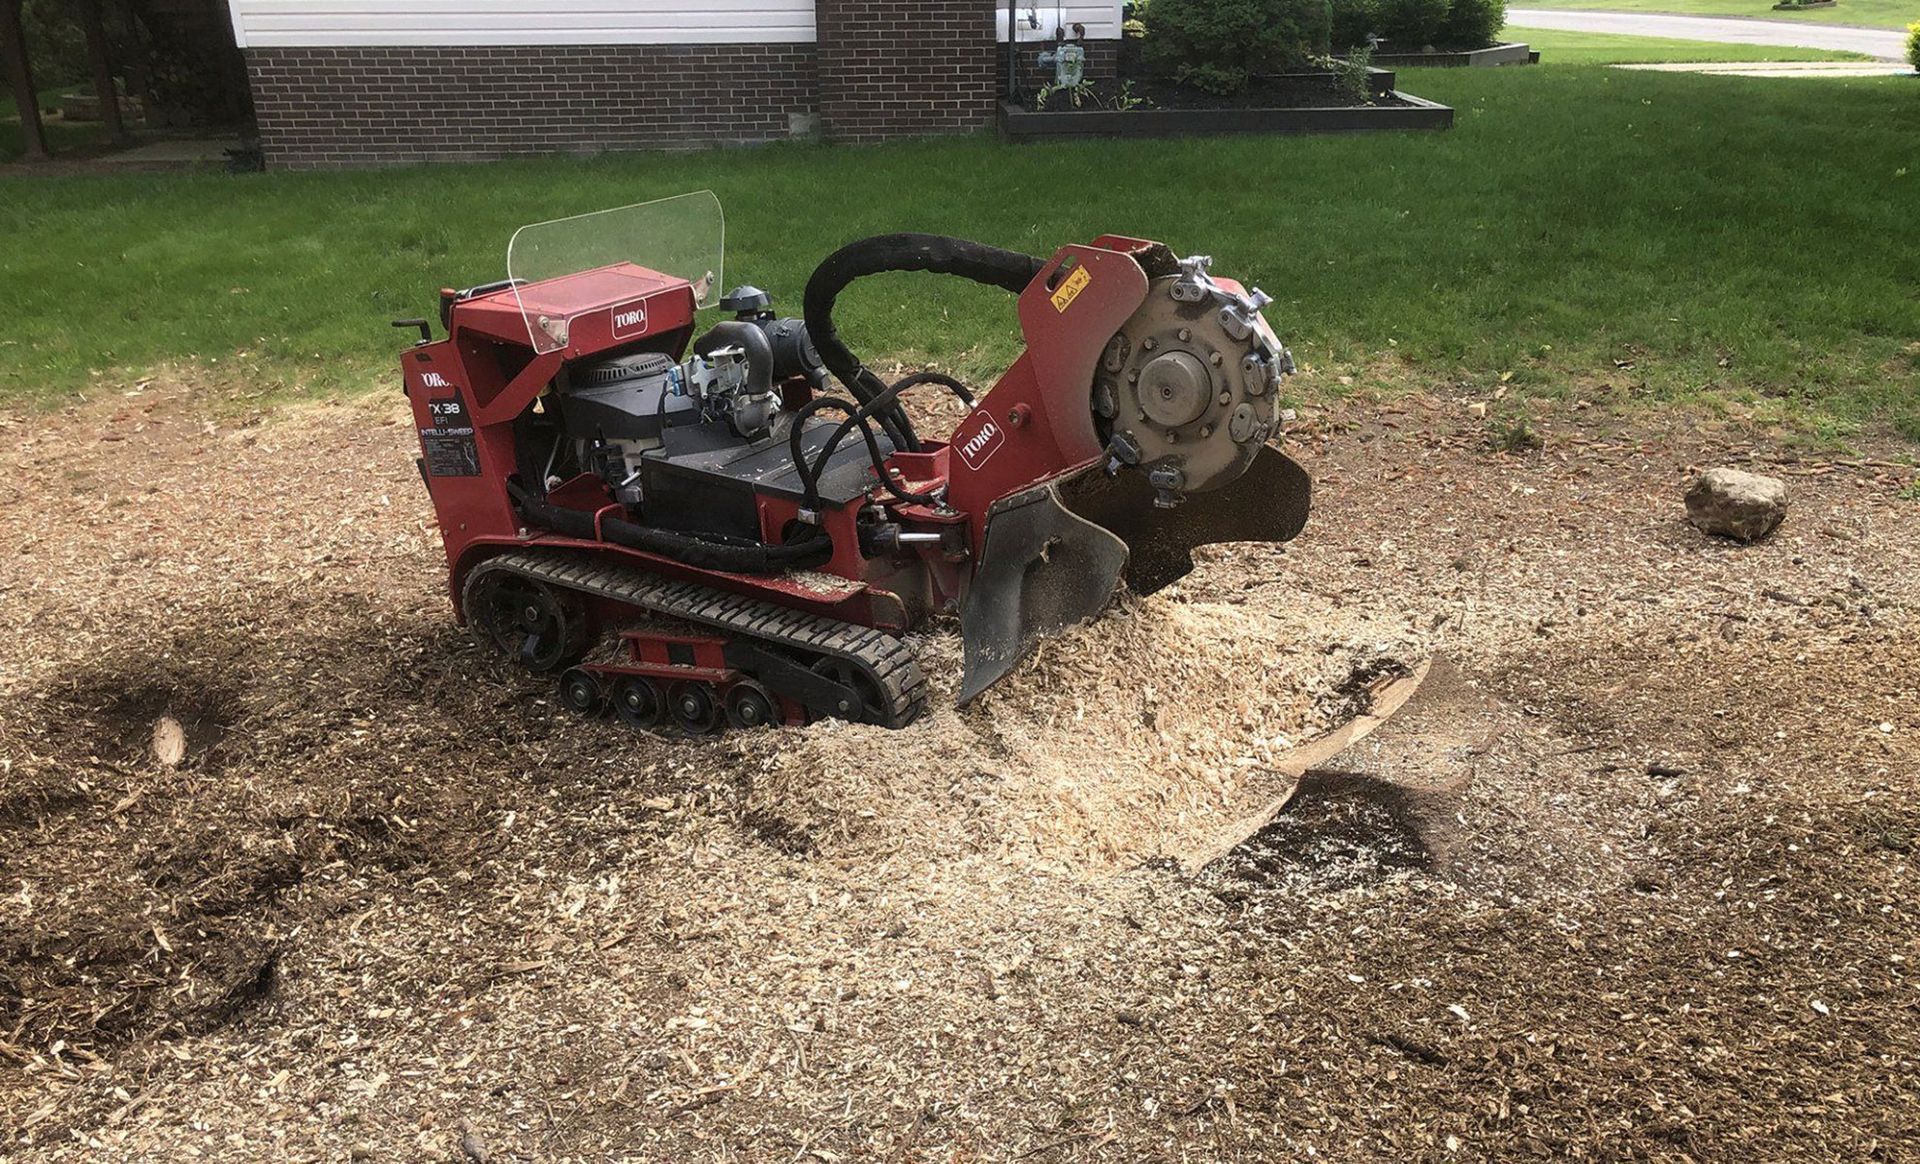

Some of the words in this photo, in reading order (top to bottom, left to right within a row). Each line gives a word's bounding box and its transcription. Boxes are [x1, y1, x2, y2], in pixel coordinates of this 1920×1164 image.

[615, 309, 644, 328] TORO
[421, 372, 451, 387] OR
[428, 403, 460, 414] X-38
[962, 422, 996, 458] TORO
